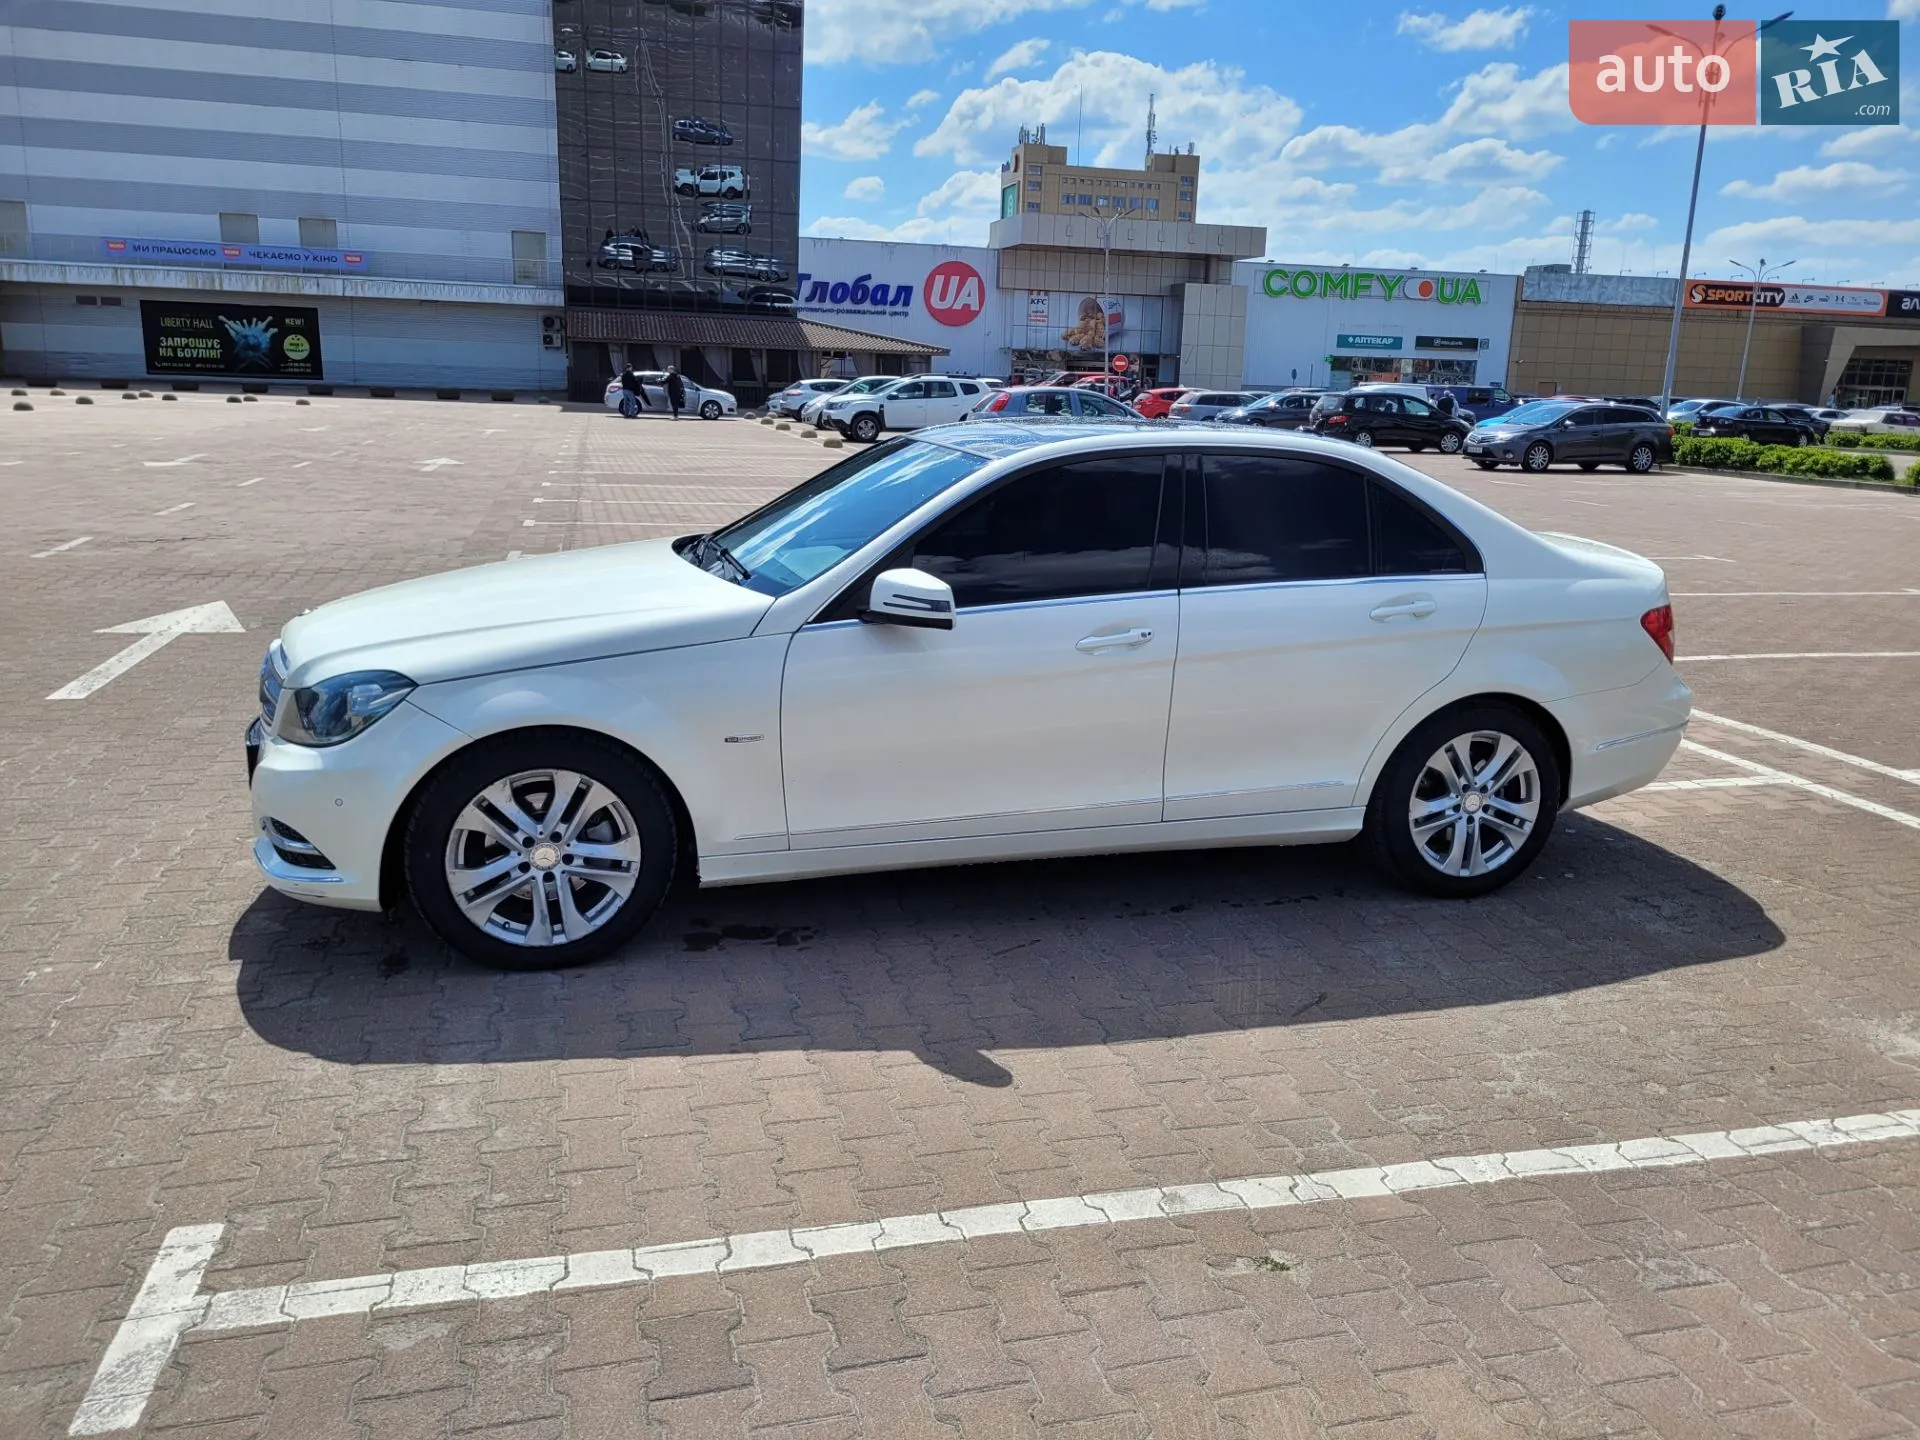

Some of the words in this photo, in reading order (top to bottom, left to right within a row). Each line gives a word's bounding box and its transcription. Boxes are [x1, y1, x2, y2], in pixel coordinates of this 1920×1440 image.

[133, 244, 149, 253] МИ
[312, 254, 338, 264] КІНО
[930, 274, 980, 311] UA
[1263, 268, 1404, 301] COMFY
[1438, 276, 1483, 304] UA
[1030, 298, 1047, 306] KFC
[1901, 297, 1920, 310] ал
[160, 317, 191, 327] LIBERTY
[193, 318, 214, 329] HALL
[159, 336, 221, 349] ЗАПРОШУЄ
[1354, 336, 1394, 346] АПТЕКАР
[159, 347, 174, 357] НА
[177, 348, 223, 359] БОУЛІНГ
